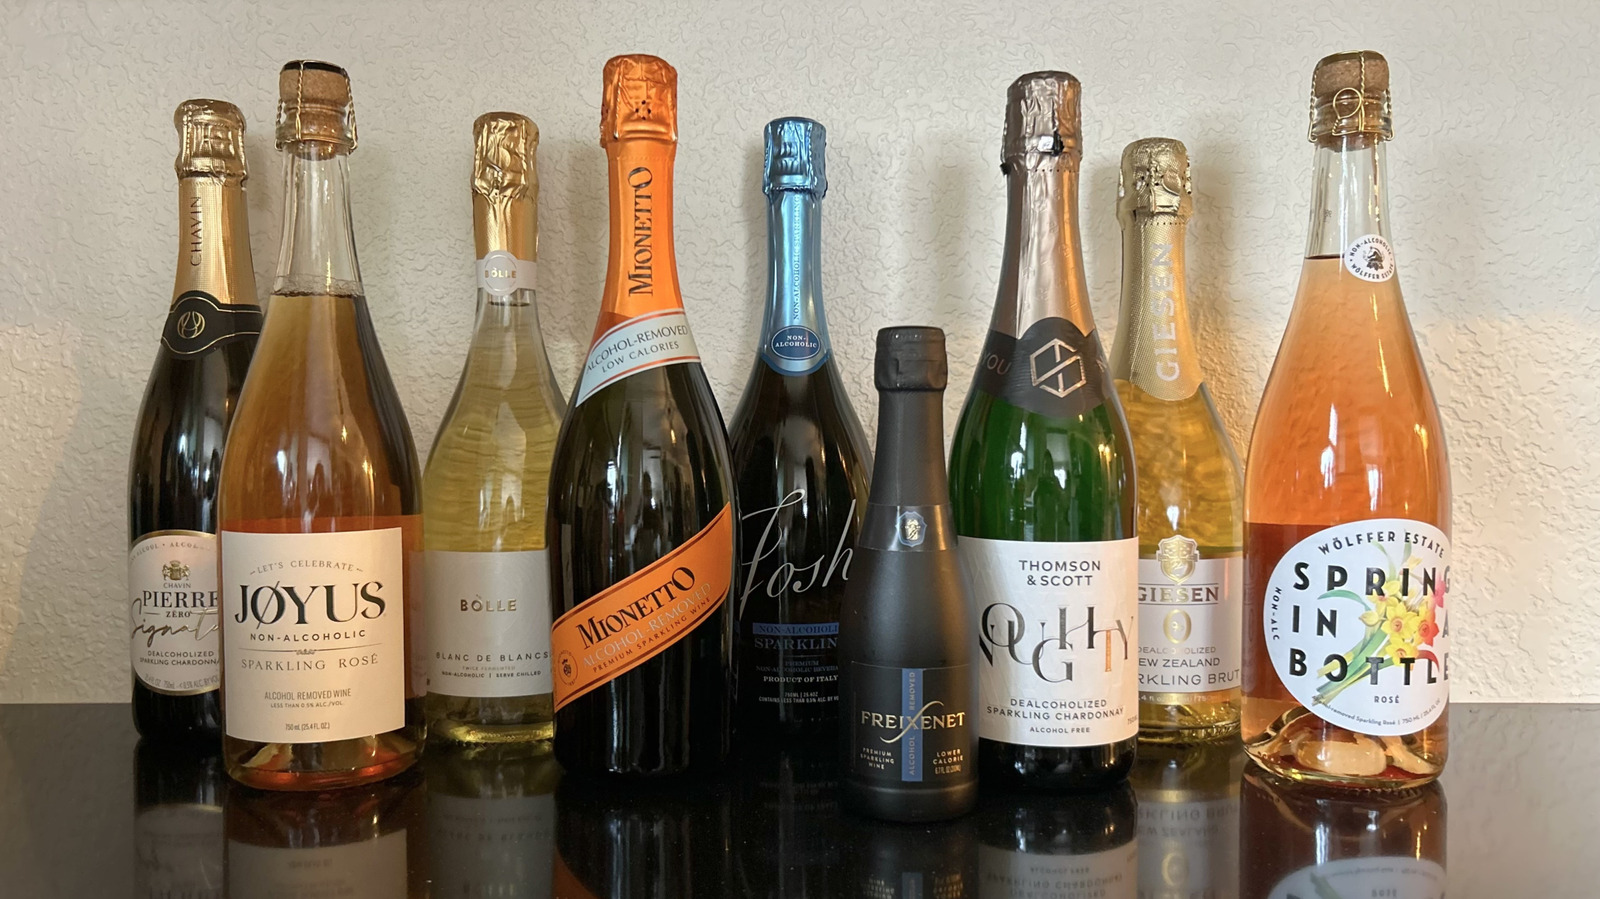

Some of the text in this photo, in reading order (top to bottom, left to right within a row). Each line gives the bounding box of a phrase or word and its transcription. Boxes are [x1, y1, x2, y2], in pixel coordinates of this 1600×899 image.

[190, 197, 202, 266] CHAVIN
[628, 166, 653, 296] MIONETTO
[1152, 243, 1180, 382] GIESEN
[586, 326, 688, 374] ALCOHOL-REMOVED
[602, 341, 680, 372] LOW CALORIES
[982, 352, 1011, 375] YOU
[1318, 531, 1444, 558] WÖLFFER ESTATE
[257, 560, 354, 574] LET'S CELEBRATE
[1019, 560, 1101, 572] THOMSON
[1028, 575, 1093, 586] & SCOTT
[1293, 562, 1450, 597] SPRING
[143, 590, 218, 608] PIERRE
[1138, 586, 1219, 602] GIESEN
[460, 594, 516, 612] BÒLLE
[576, 567, 695, 650] MIONETTO
[130, 598, 218, 647] Signat
[1292, 605, 1337, 638] IN
[250, 630, 366, 642] NON-ALCOHOLIC
[593, 598, 710, 672] PREMIUM SPARKLING WINE
[760, 625, 838, 634] NON-ALCOHOLI
[754, 638, 838, 650] SPARKLIN
[979, 602, 1134, 683] NOUGHTY
[140, 657, 219, 666] SPARKLING CHARDONN
[241, 653, 378, 671] SPARKLING ROSÉ
[436, 652, 469, 662] BLANC
[477, 654, 491, 662] DE
[500, 652, 548, 662] BLANCS
[1139, 658, 1220, 667] EW ZEALAND
[1289, 648, 1449, 685] BOTTLE
[1138, 669, 1240, 685] RKLING BRUT
[264, 688, 351, 701] ALCOHOL REMOVED WINE
[1374, 695, 1400, 704] ROSÉ
[1010, 698, 1107, 710] DEALCOHOLIZED
[986, 706, 1124, 721] SPARKLING CHARDONNAY
[1356, 716, 1381, 726] Sparkling
[860, 753, 894, 764] SPARKLING
[862, 748, 892, 757] PREMIUM
[933, 755, 963, 765] CALORIE
[936, 749, 960, 758] LOWER
[869, 762, 885, 770] WINE
